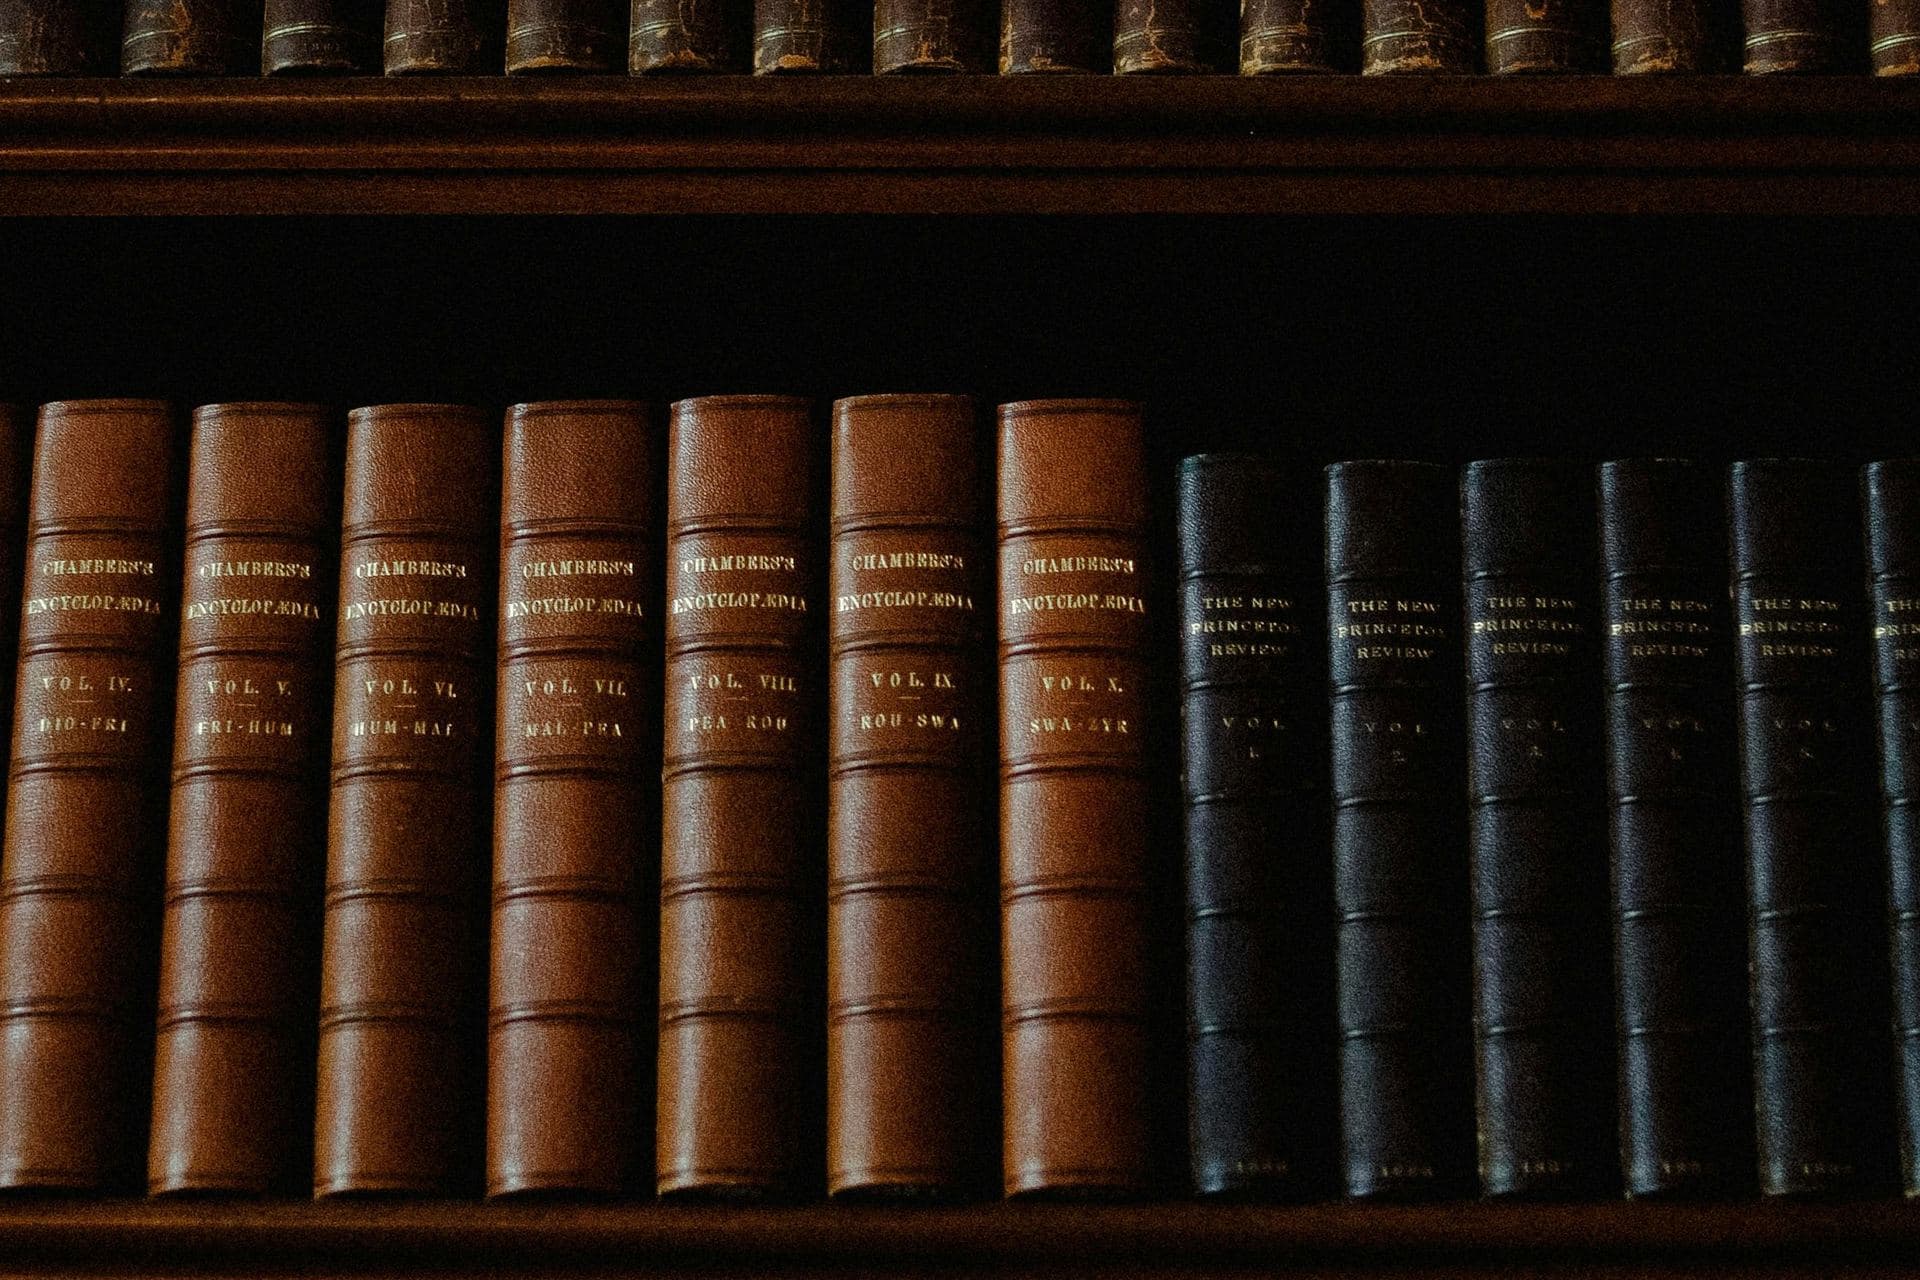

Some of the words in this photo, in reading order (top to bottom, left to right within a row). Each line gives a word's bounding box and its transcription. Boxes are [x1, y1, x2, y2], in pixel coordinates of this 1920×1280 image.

[43, 559, 154, 576] CHAMBERS'S
[200, 561, 310, 577] CHAMBERS'S
[356, 560, 466, 577] CHAMBERS'S
[523, 560, 634, 576] CHAMBERS'S
[684, 555, 795, 573] CHAMBERS'S
[853, 553, 964, 570] CHAMBERS'S
[1023, 556, 1134, 575] CHAMBERS'S
[1203, 597, 1242, 609] THE
[1348, 600, 1389, 613] THE
[1488, 597, 1526, 608] THE
[1622, 599, 1662, 611] THE
[1752, 599, 1791, 611] THE
